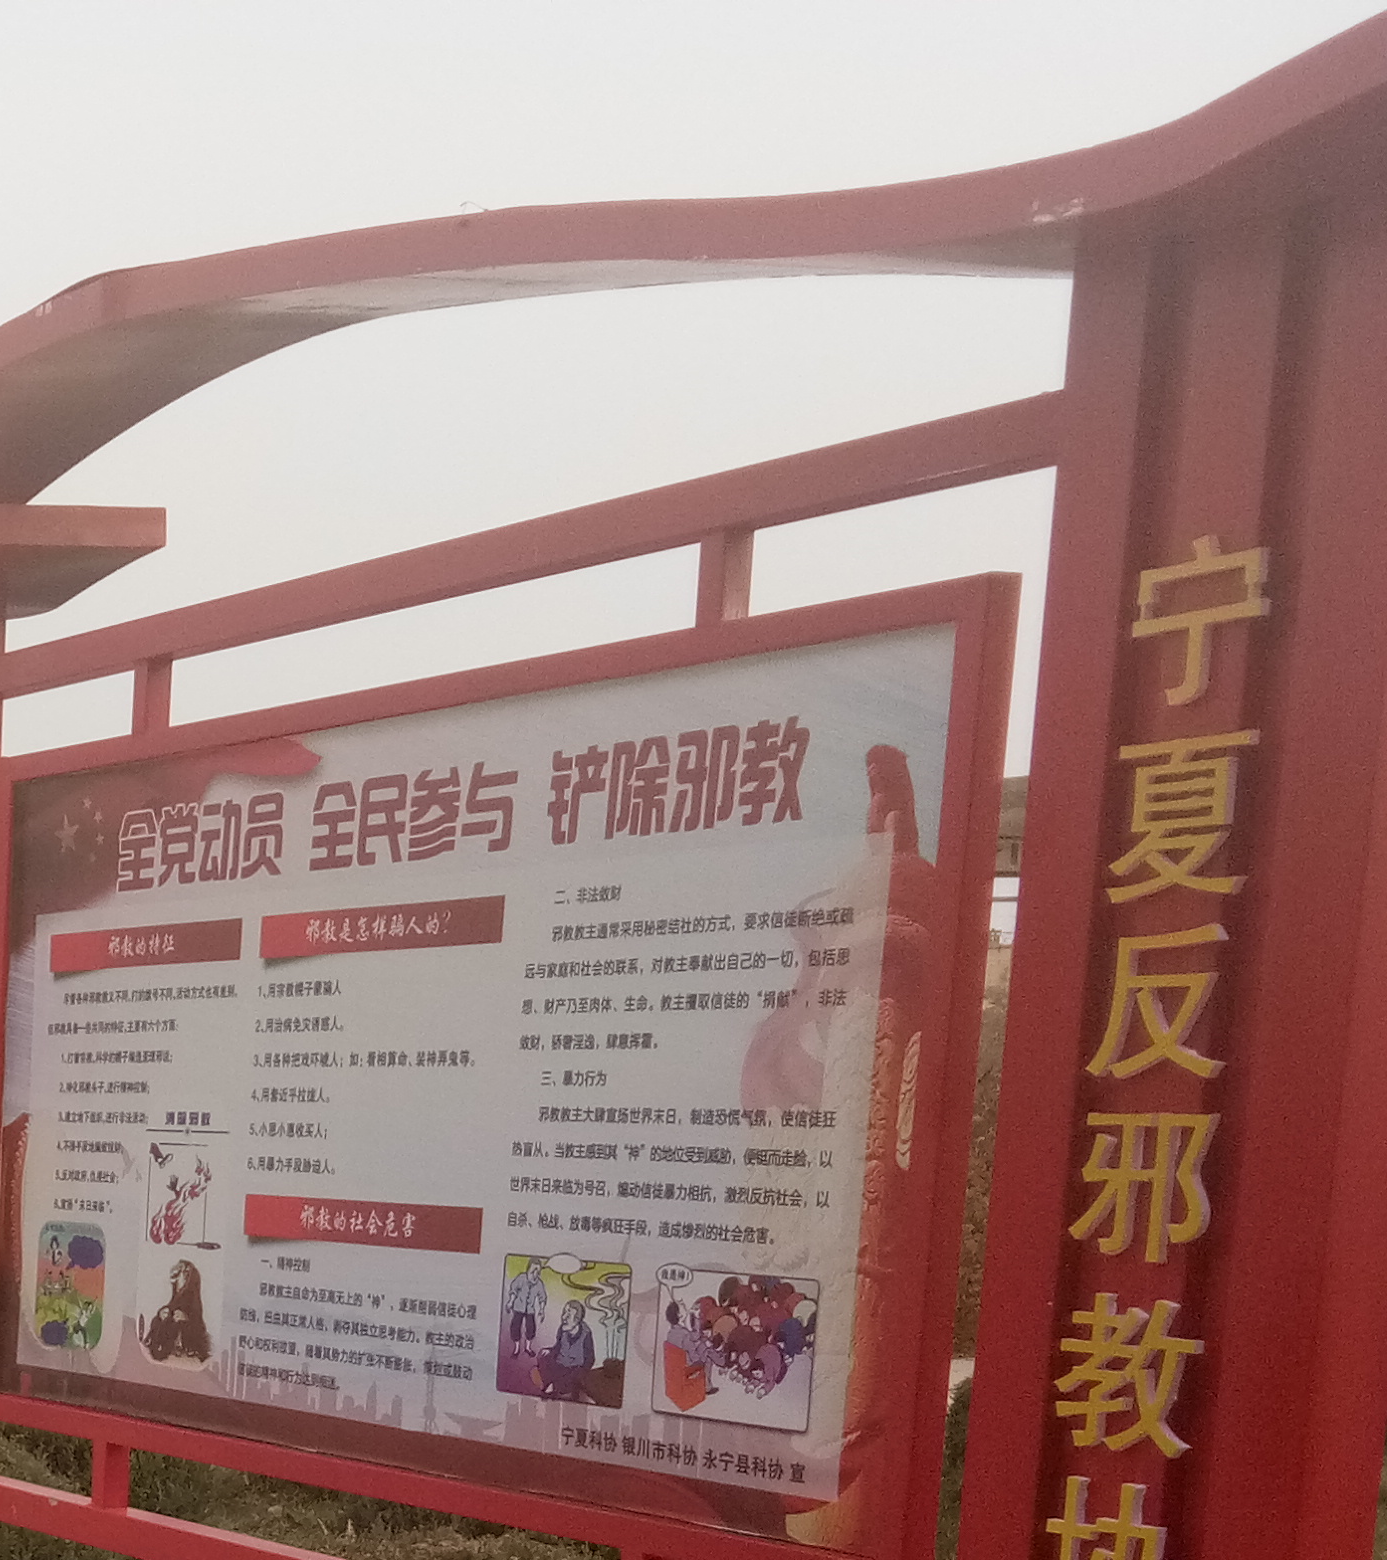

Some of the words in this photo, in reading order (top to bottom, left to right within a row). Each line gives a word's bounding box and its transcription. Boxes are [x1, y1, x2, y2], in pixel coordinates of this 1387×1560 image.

[117, 793, 284, 892] 全党动员
[309, 761, 518, 872] 全民参与
[547, 716, 811, 846] 铲除邪教
[108, 933, 176, 958] 邪教的特征
[540, 1070, 607, 1087] 三、暴力行为
[300, 1204, 416, 1238] 邪教的社会危害
[562, 1425, 617, 1452] 宁夏科协
[622, 1435, 698, 1467] 银川市科协
[702, 1449, 784, 1480] 永宁县科协
[790, 1462, 806, 1484] 宣
